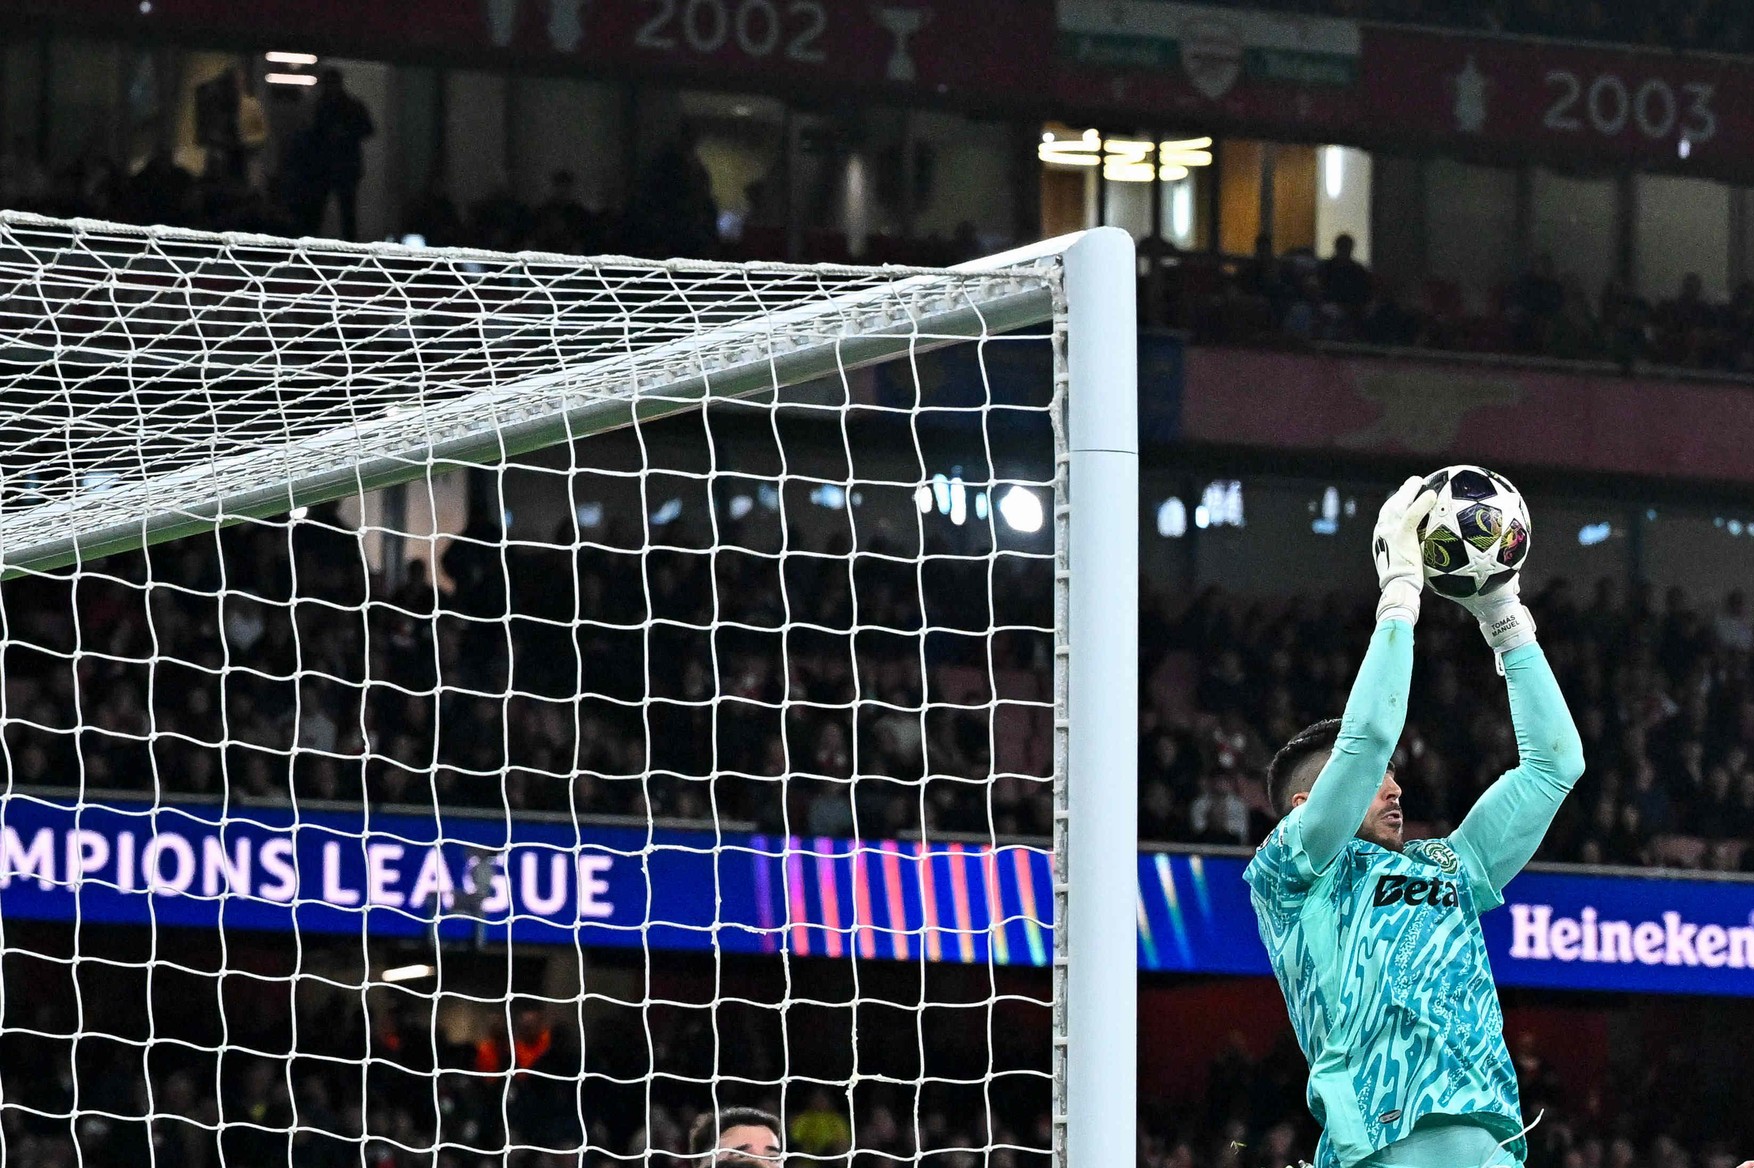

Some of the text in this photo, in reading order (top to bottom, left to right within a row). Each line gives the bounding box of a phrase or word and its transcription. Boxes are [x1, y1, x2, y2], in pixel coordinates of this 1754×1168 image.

[635, 0, 828, 62] 2002
[1543, 70, 1717, 142] 2003
[1491, 614, 1516, 630] TOMÁS
[1491, 620, 1520, 638] MANUEL
[0, 826, 294, 901] MPIONS
